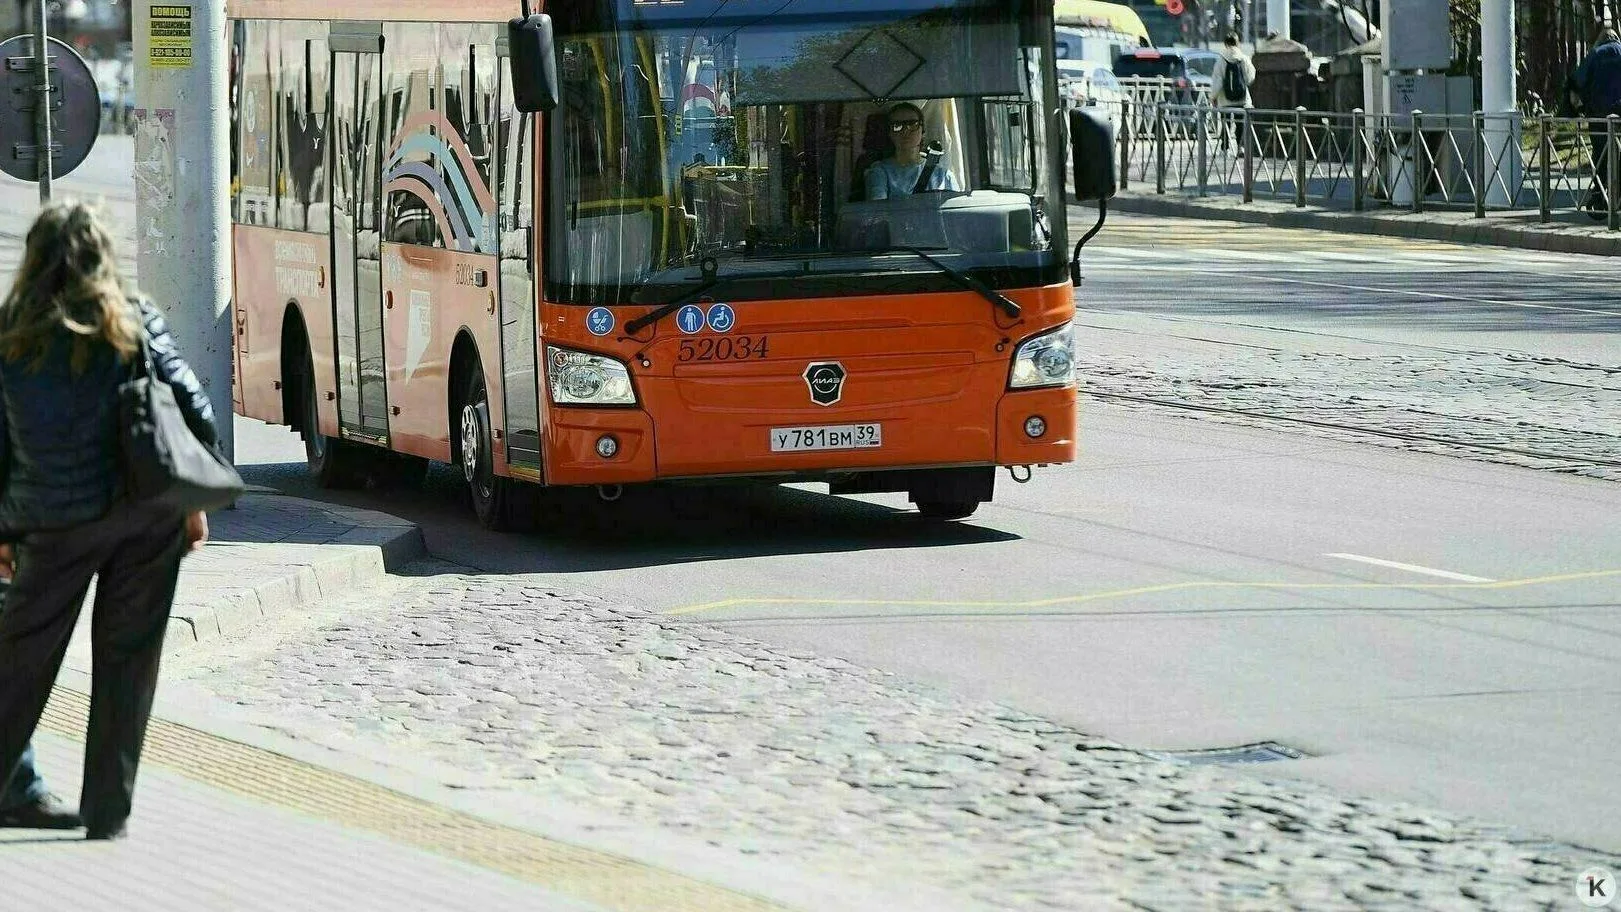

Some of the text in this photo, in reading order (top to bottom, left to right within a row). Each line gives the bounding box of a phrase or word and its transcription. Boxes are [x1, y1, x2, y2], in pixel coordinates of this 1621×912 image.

[152, 7, 189, 17] ПОМОЩЬ
[677, 336, 770, 361] 52034
[856, 425, 875, 440] 39
